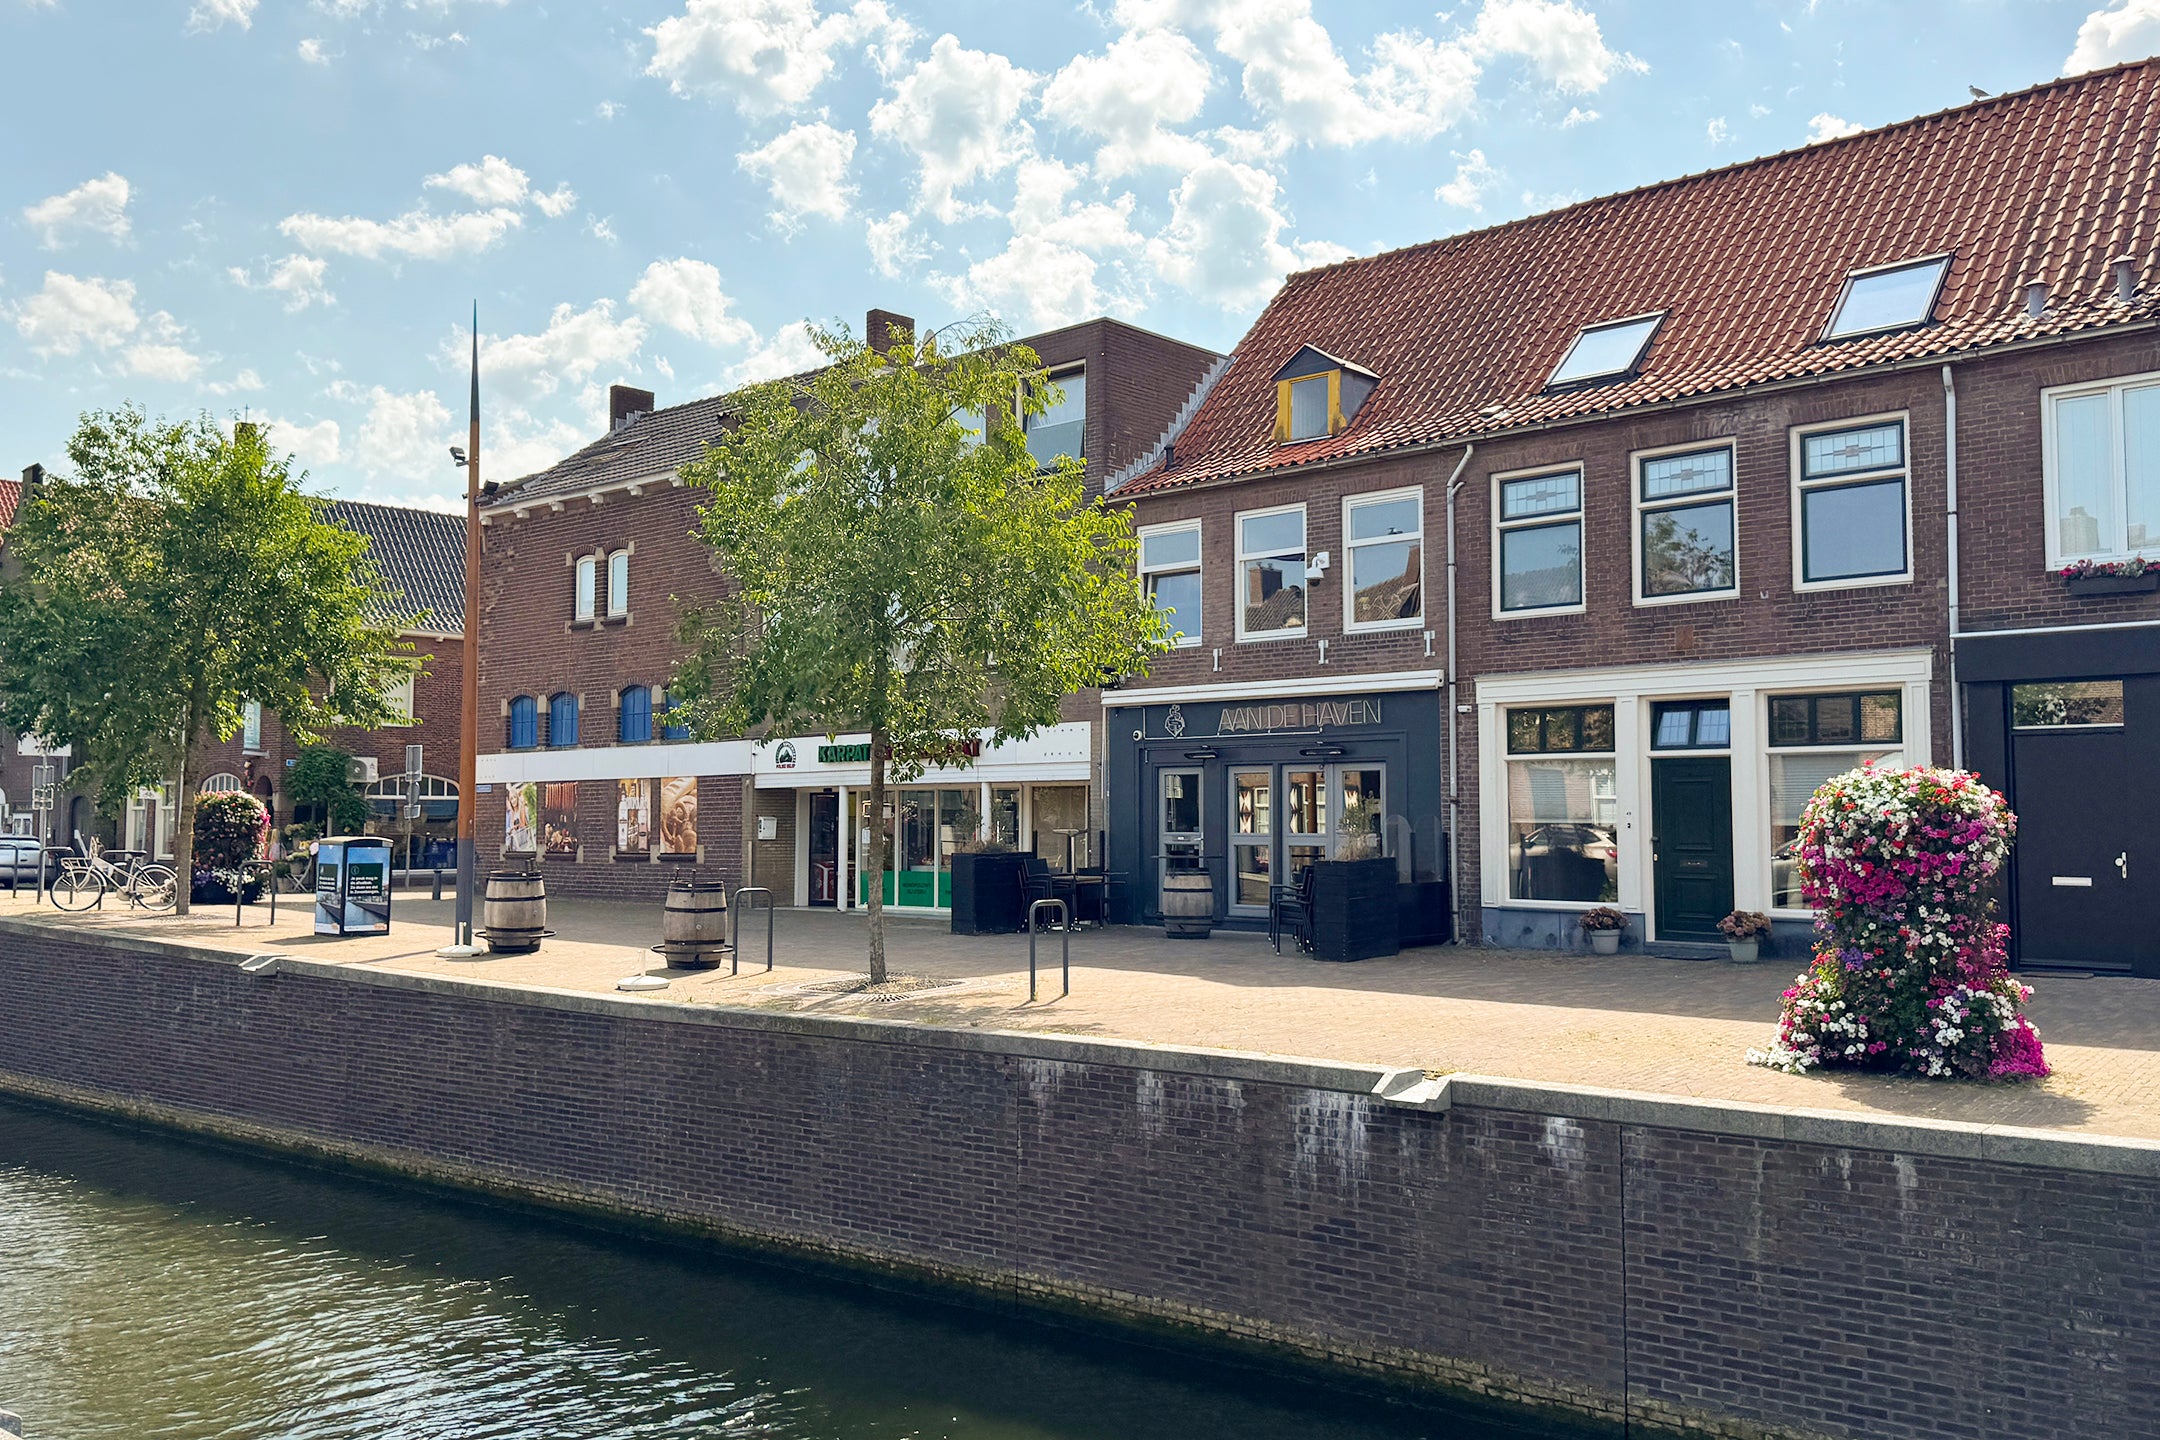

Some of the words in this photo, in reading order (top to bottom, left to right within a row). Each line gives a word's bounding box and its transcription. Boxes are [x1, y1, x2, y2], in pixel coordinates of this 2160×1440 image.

[1218, 708, 1263, 732] AAN
[1268, 705, 1297, 729] DE
[1302, 699, 1381, 727] HAVEN
[818, 744, 871, 762] KARPAT
